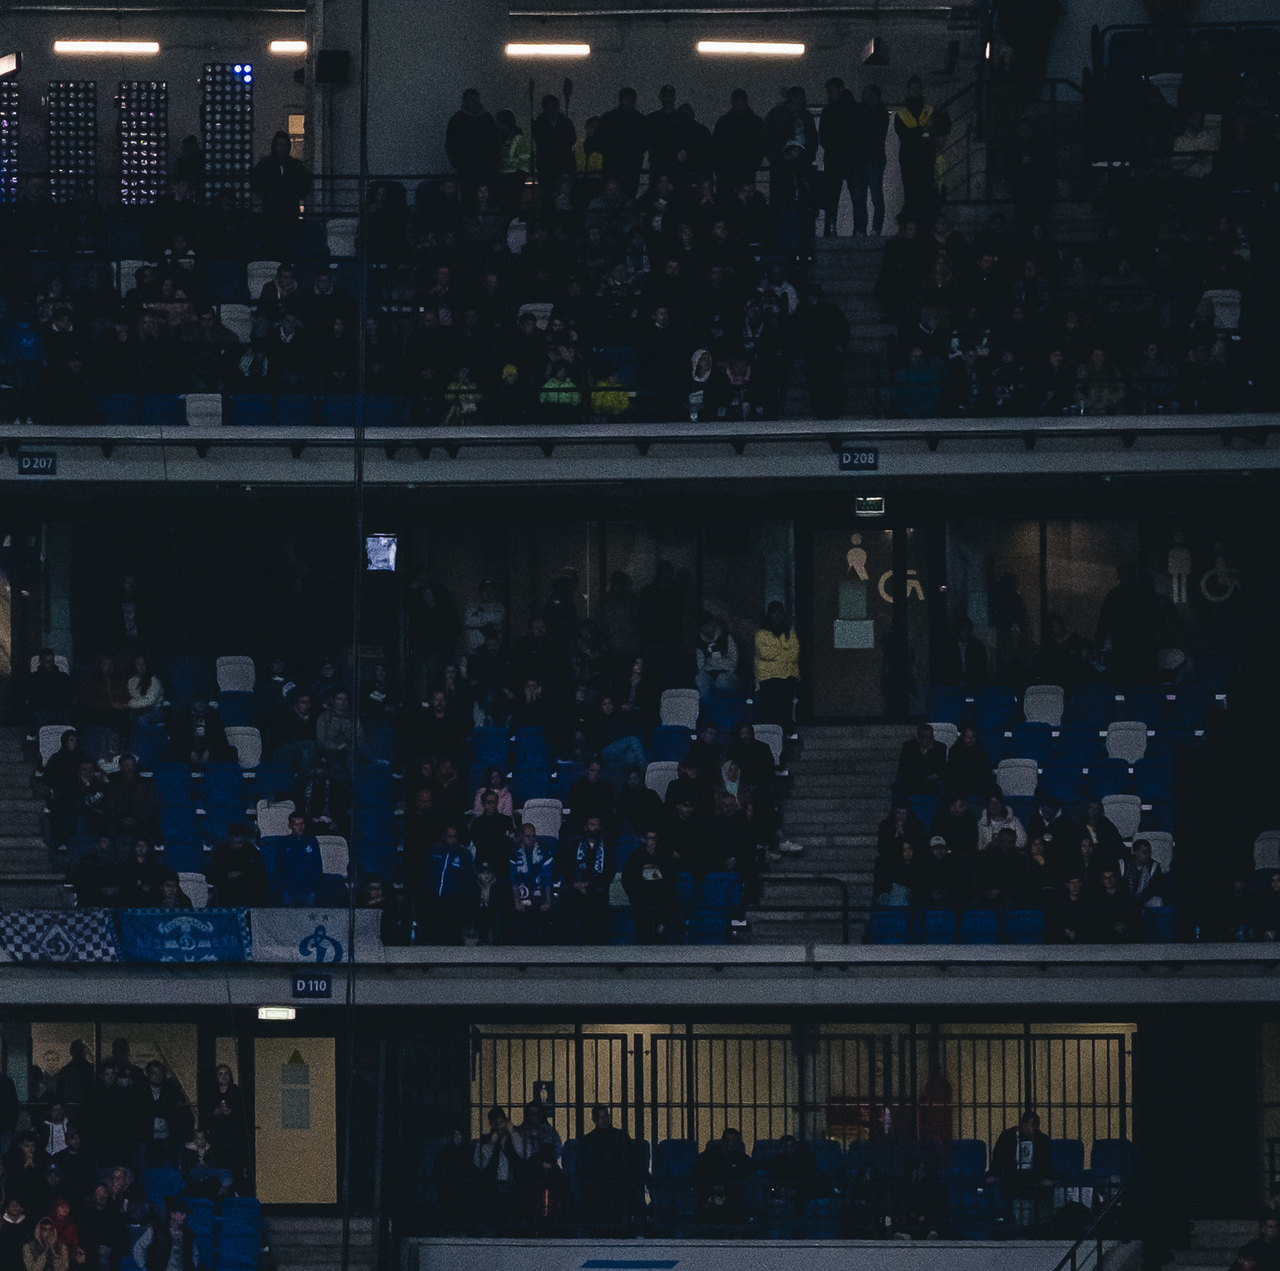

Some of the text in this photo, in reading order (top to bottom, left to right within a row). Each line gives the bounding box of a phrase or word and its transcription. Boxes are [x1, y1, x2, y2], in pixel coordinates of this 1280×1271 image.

[22, 457, 53, 469] D 207
[842, 452, 875, 464] D 208
[297, 979, 327, 991] D 110
